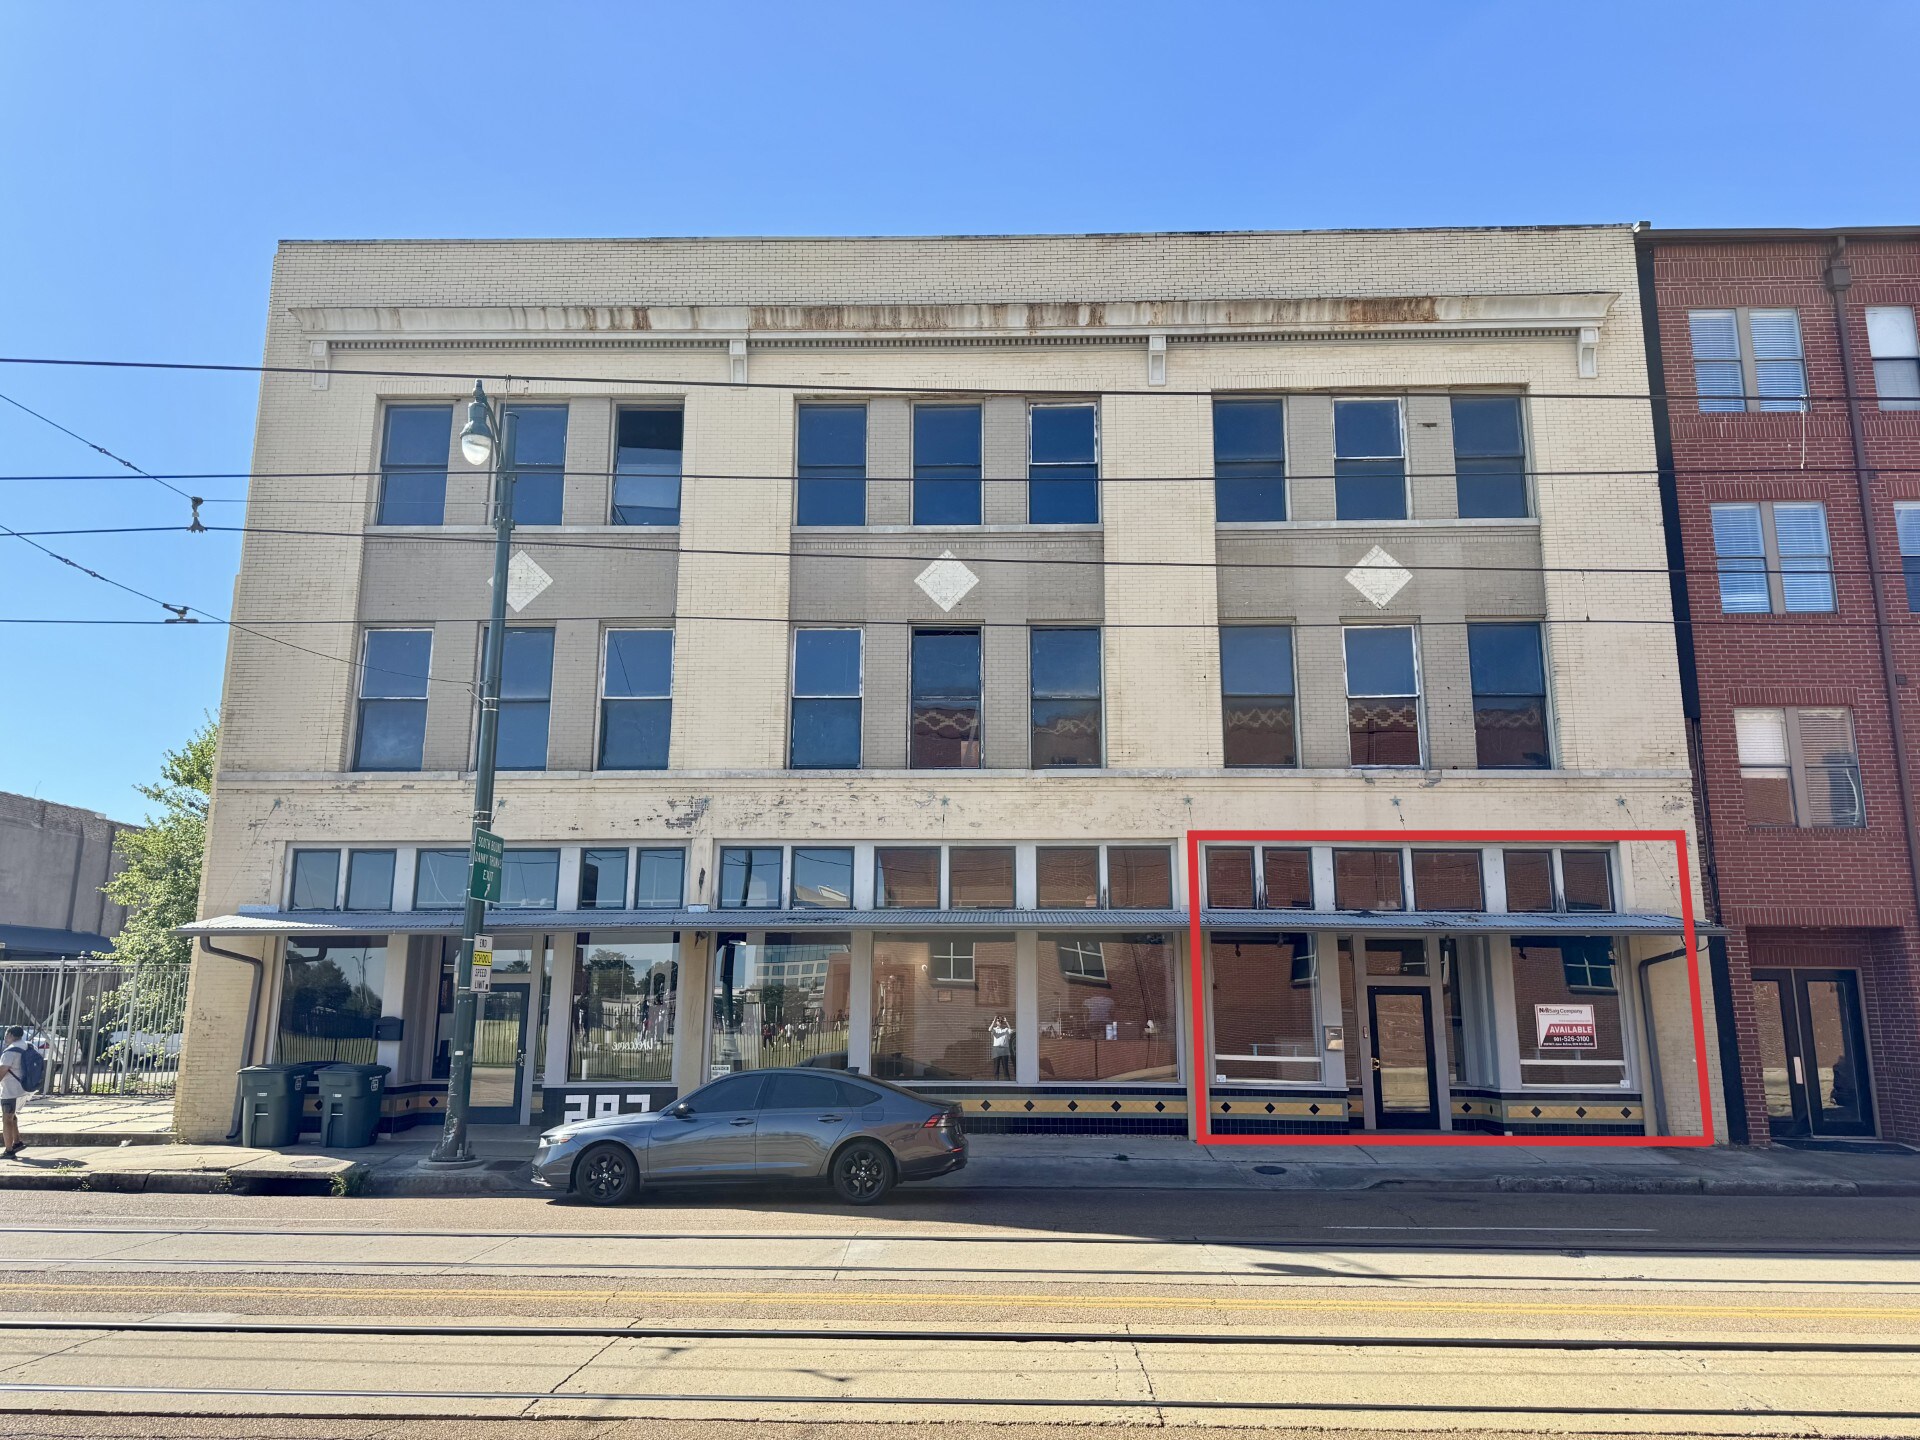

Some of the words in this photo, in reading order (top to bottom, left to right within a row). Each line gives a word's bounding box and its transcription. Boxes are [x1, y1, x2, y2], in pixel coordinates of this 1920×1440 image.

[482, 869, 494, 882] EXIT
[479, 938, 487, 948] END
[474, 953, 491, 964] SCHOOL
[474, 968, 488, 978] SPEED
[474, 980, 485, 989] LIMIT
[1549, 1025, 1593, 1034] AVAILABLE
